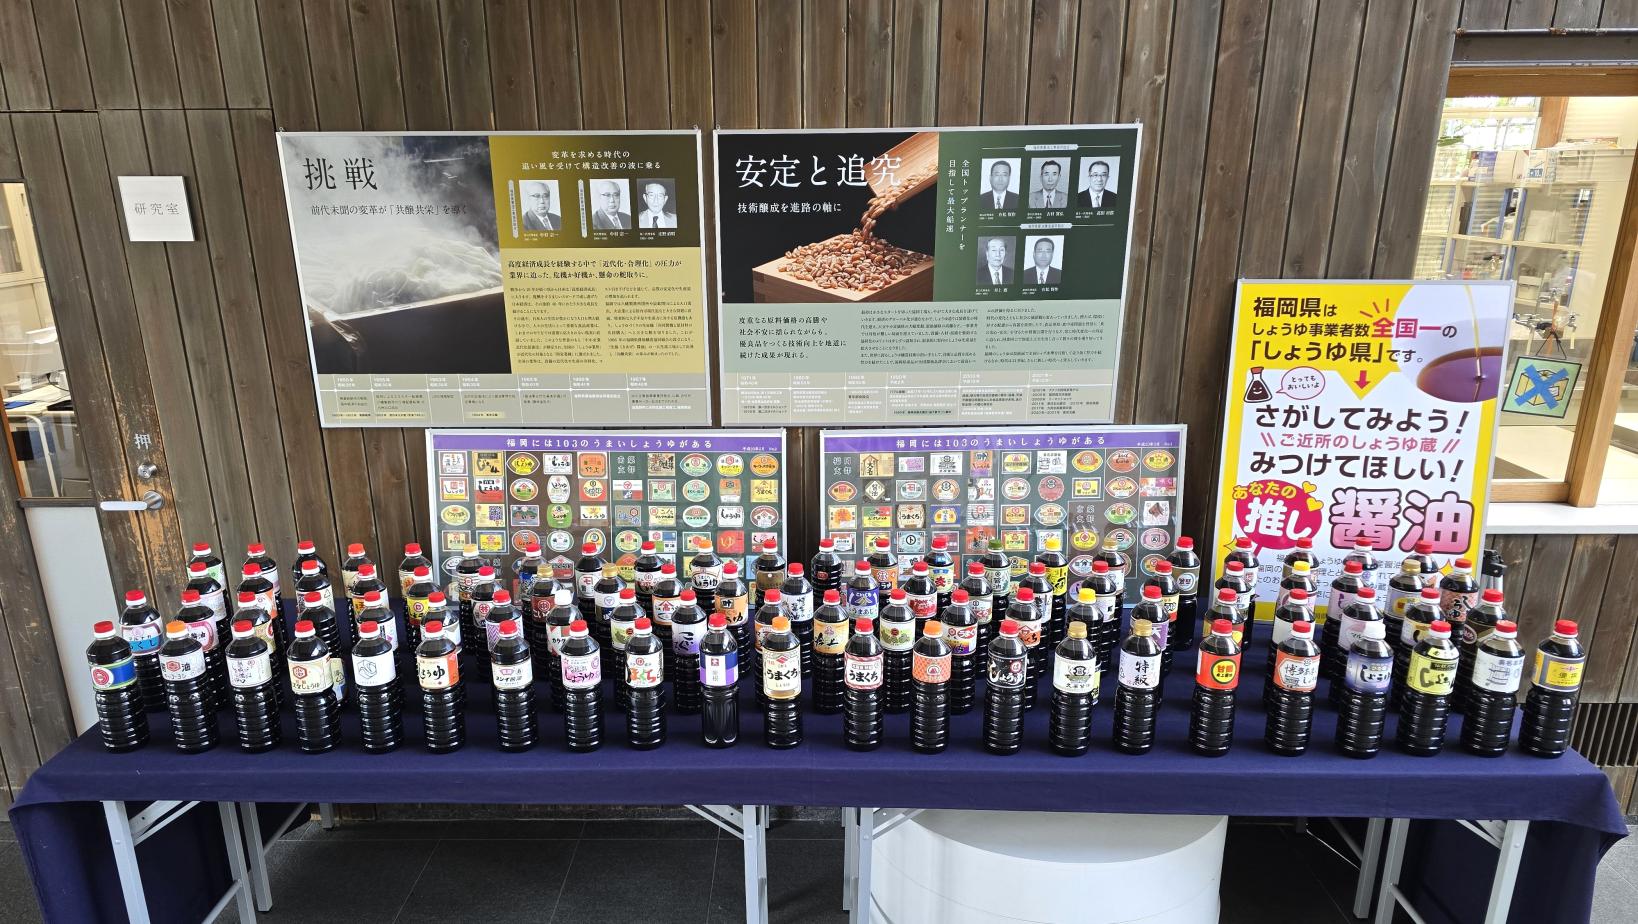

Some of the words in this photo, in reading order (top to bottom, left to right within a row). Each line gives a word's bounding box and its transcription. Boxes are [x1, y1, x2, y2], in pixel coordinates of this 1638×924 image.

[551, 150, 630, 159] 変革を求める時代の
[521, 161, 661, 170] 追い風を受けて構造改善の波に乗る
[735, 154, 901, 188] 安定と追究
[302, 157, 378, 191] 挑戦
[134, 202, 180, 216] 研究室
[311, 204, 467, 216] 前代未聞の変革が「共醸共栄」を導く
[737, 202, 842, 213] 技術醸成を進路の軸に
[959, 159, 970, 251] 全国トップランナーを
[1253, 297, 1337, 317] 福岡県は
[738, 316, 828, 324] 度重なる原料価格の高騰や
[739, 339, 847, 348] 優良品をつくる技術向上を地道に
[739, 351, 809, 360] 続けた成果が現れる。
[1287, 382, 1320, 390] おいしいよ
[134, 433, 151, 450] 押
[507, 438, 712, 449] 福岡には103のうまいしょうゆがある
[896, 436, 1105, 448] 福岡には103のうまいしょうゆがある
[1280, 433, 1438, 453] ご近所のしょうゆ蔵
[1232, 482, 1297, 500] あなたの
[1245, 497, 1312, 541] 推し
[1329, 486, 1475, 555] 醤油
[766, 667, 798, 681] うまくち
[849, 670, 879, 683] うまくち
